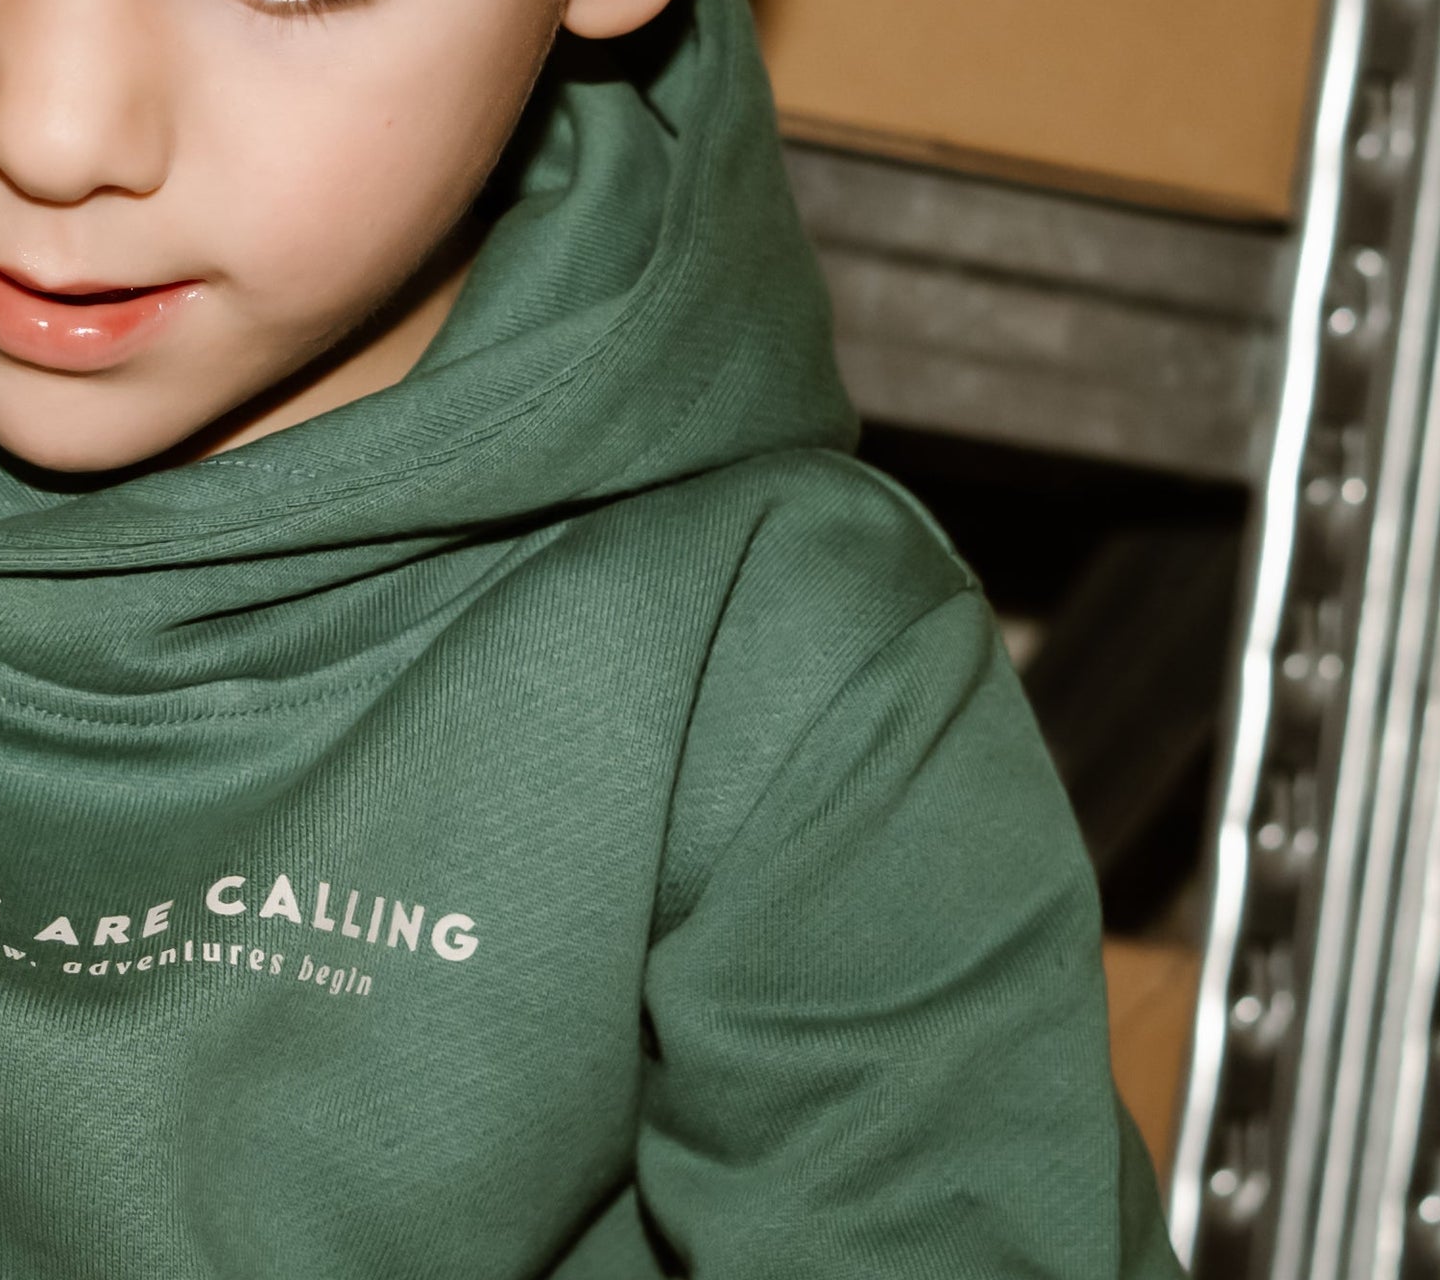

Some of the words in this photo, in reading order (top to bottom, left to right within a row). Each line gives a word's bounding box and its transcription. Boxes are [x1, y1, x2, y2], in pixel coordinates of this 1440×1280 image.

[33, 900, 174, 946] ARE
[205, 874, 479, 962] CALLING
[62, 939, 284, 976] adventures
[297, 954, 373, 997] begin
